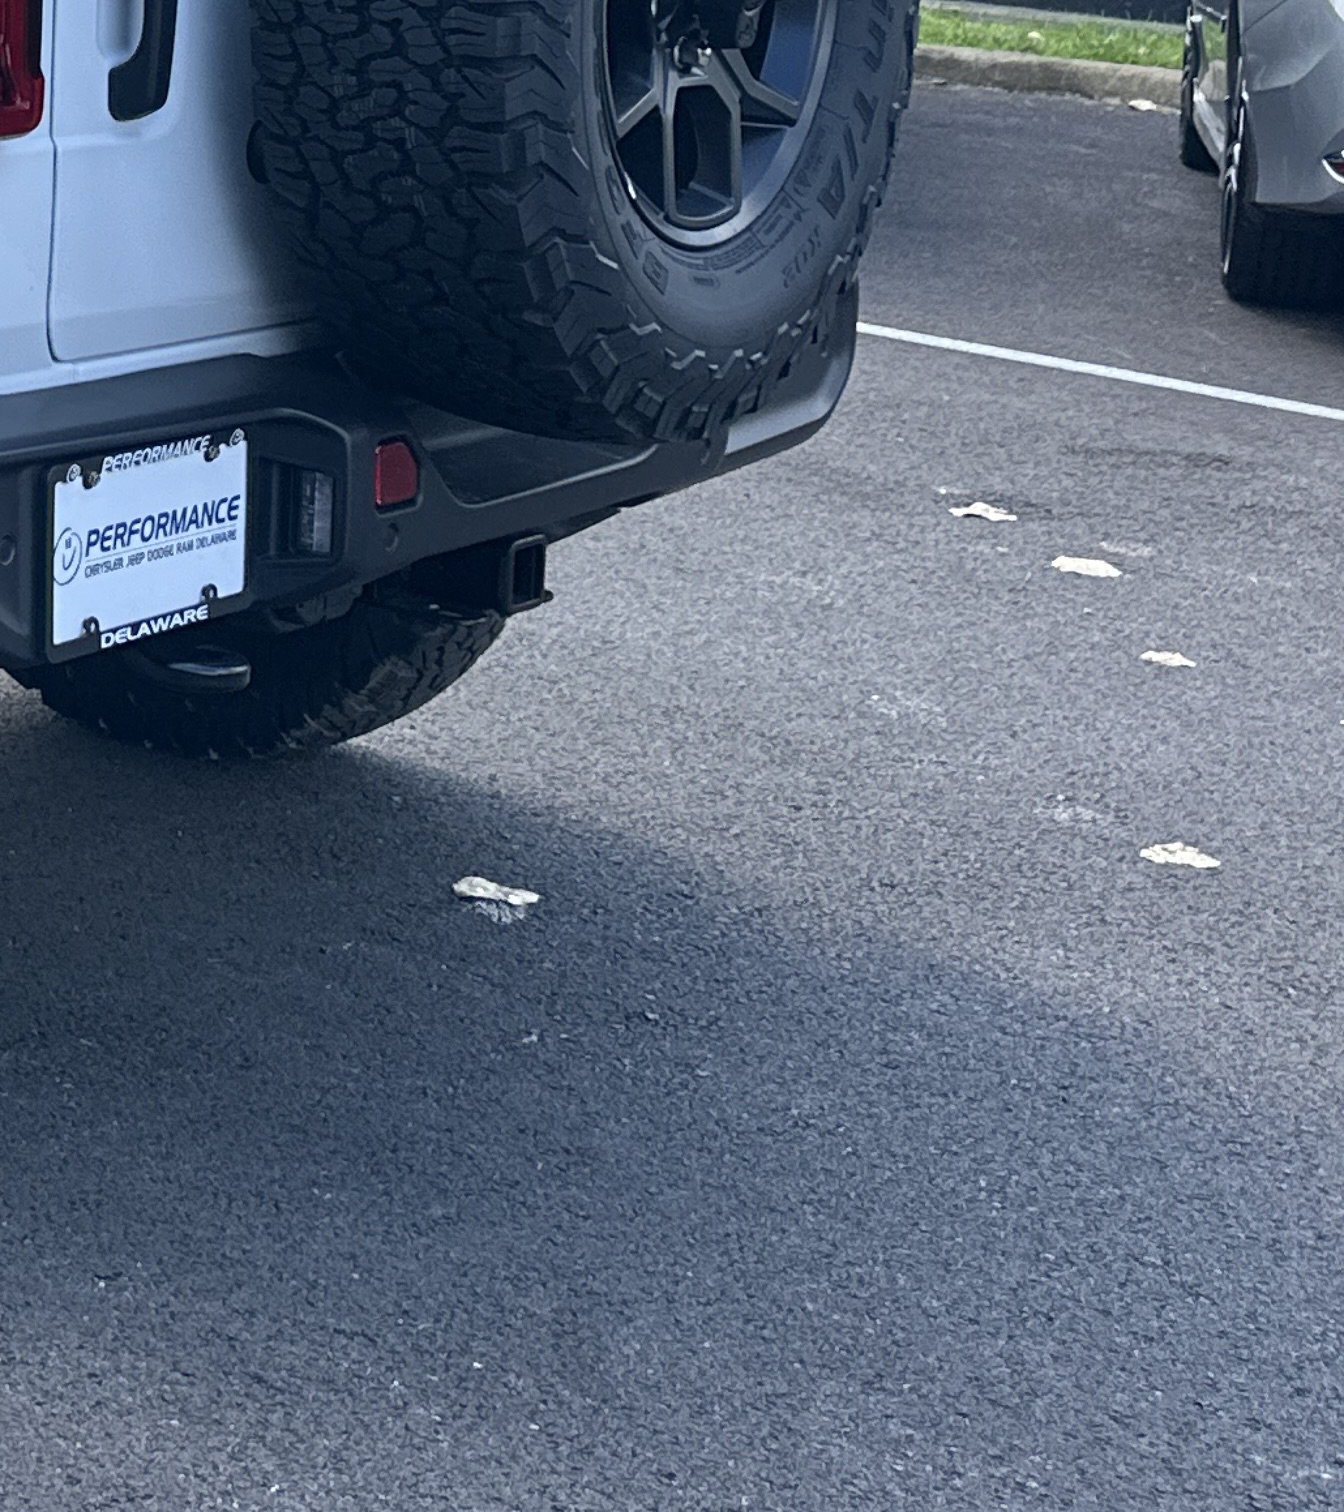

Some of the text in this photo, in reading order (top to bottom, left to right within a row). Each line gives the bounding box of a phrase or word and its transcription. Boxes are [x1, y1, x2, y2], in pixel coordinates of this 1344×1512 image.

[816, 88, 877, 220] T/A
[101, 434, 212, 474] PERFORMANCE
[85, 494, 241, 558] PERFORMANCE
[84, 556, 124, 578] CHRYSLER
[126, 551, 146, 568] JEEP
[147, 543, 175, 563] DODGE
[176, 538, 194, 555] RAM
[100, 604, 209, 649] DELAWARE
